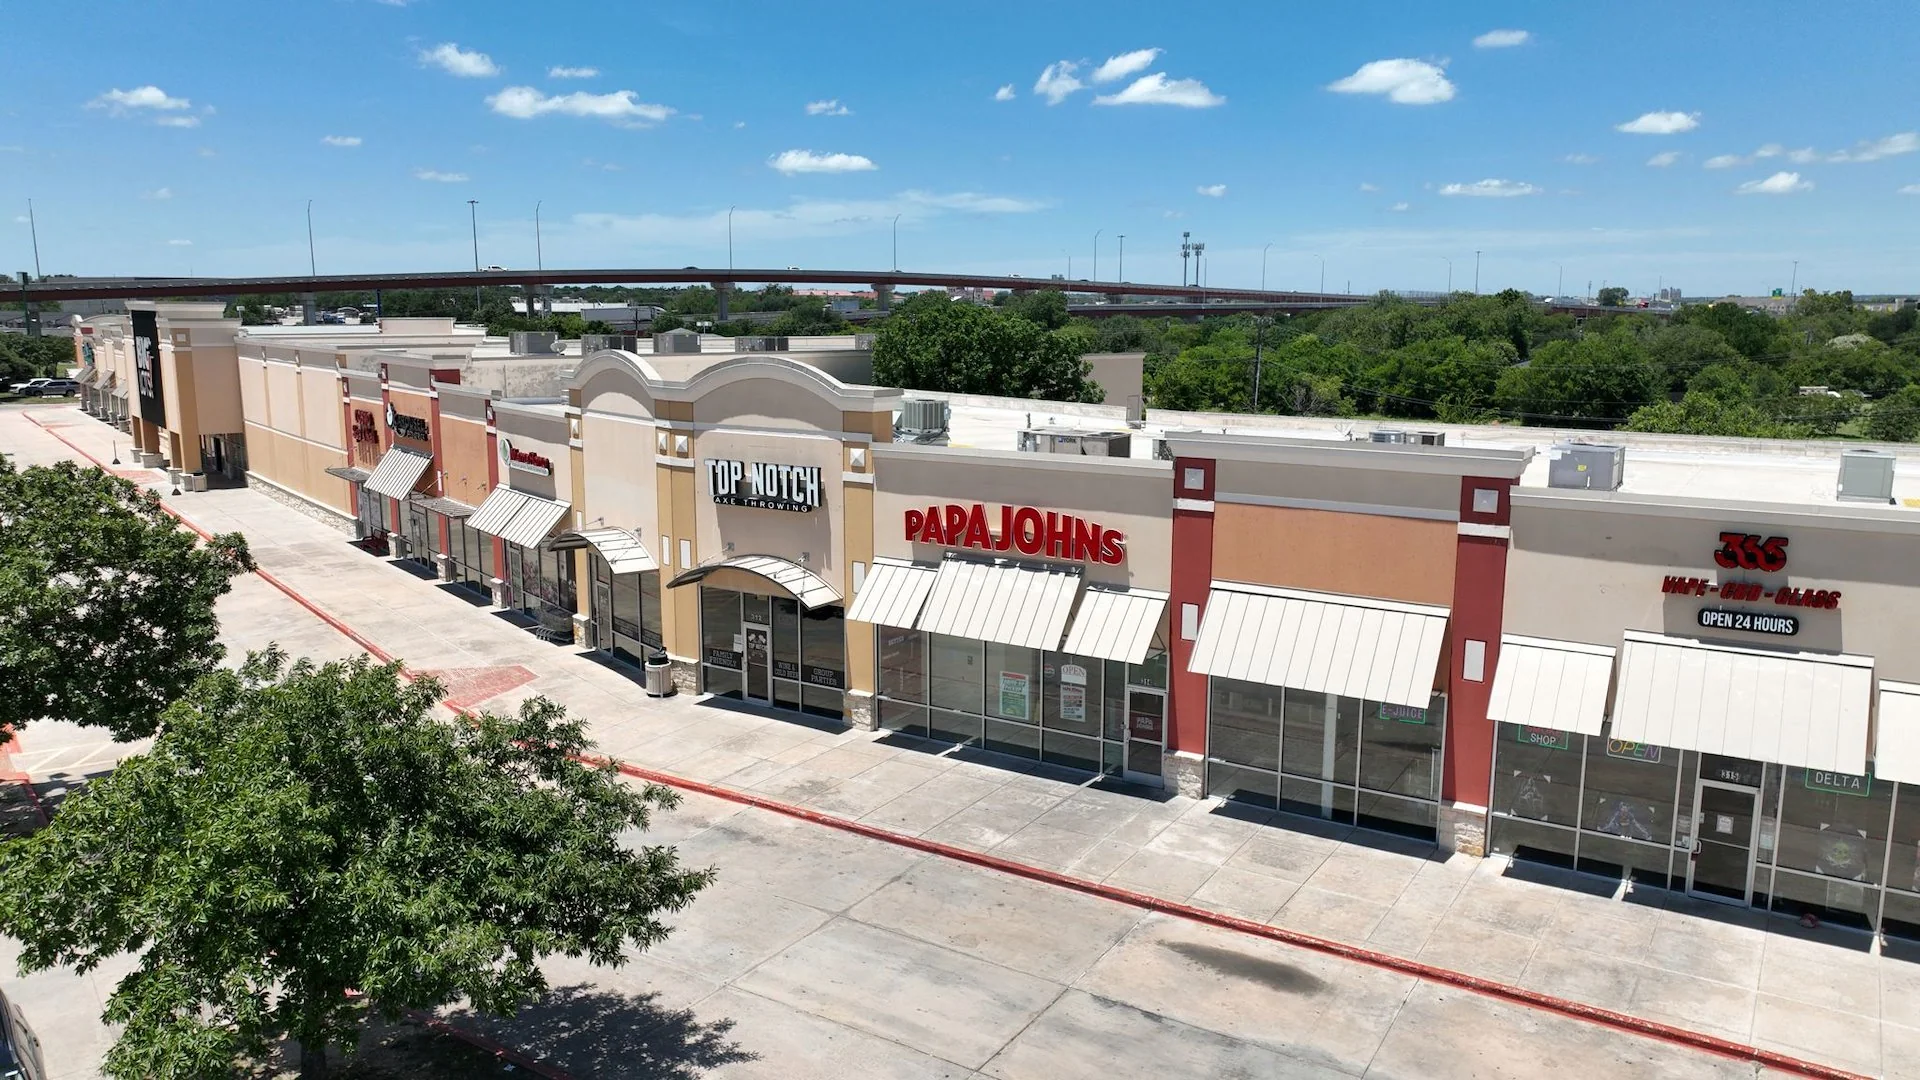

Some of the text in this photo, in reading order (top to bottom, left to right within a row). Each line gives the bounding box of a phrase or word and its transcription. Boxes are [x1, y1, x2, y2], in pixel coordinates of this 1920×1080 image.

[704, 459, 821, 507] TOP NOTCH
[715, 496, 808, 513] AXE THROWING
[905, 503, 1125, 567] PAPA JOHNS
[1714, 532, 1789, 573] 365
[1661, 576, 1709, 597] VAPE
[1774, 587, 1842, 610] GLASS
[1702, 611, 1794, 634] OPEN 24 HOURS
[709, 656, 737, 667] FRIENDLY
[712, 650, 733, 660] FAMILY
[813, 668, 834, 678] GROUP
[1062, 665, 1086, 677] OPEN
[811, 674, 837, 686] PARTIES
[1382, 704, 1424, 719] E-JUICE
[1530, 733, 1556, 745] SHOP
[1610, 740, 1660, 758] OPEN
[1815, 771, 1860, 789] DELTA
